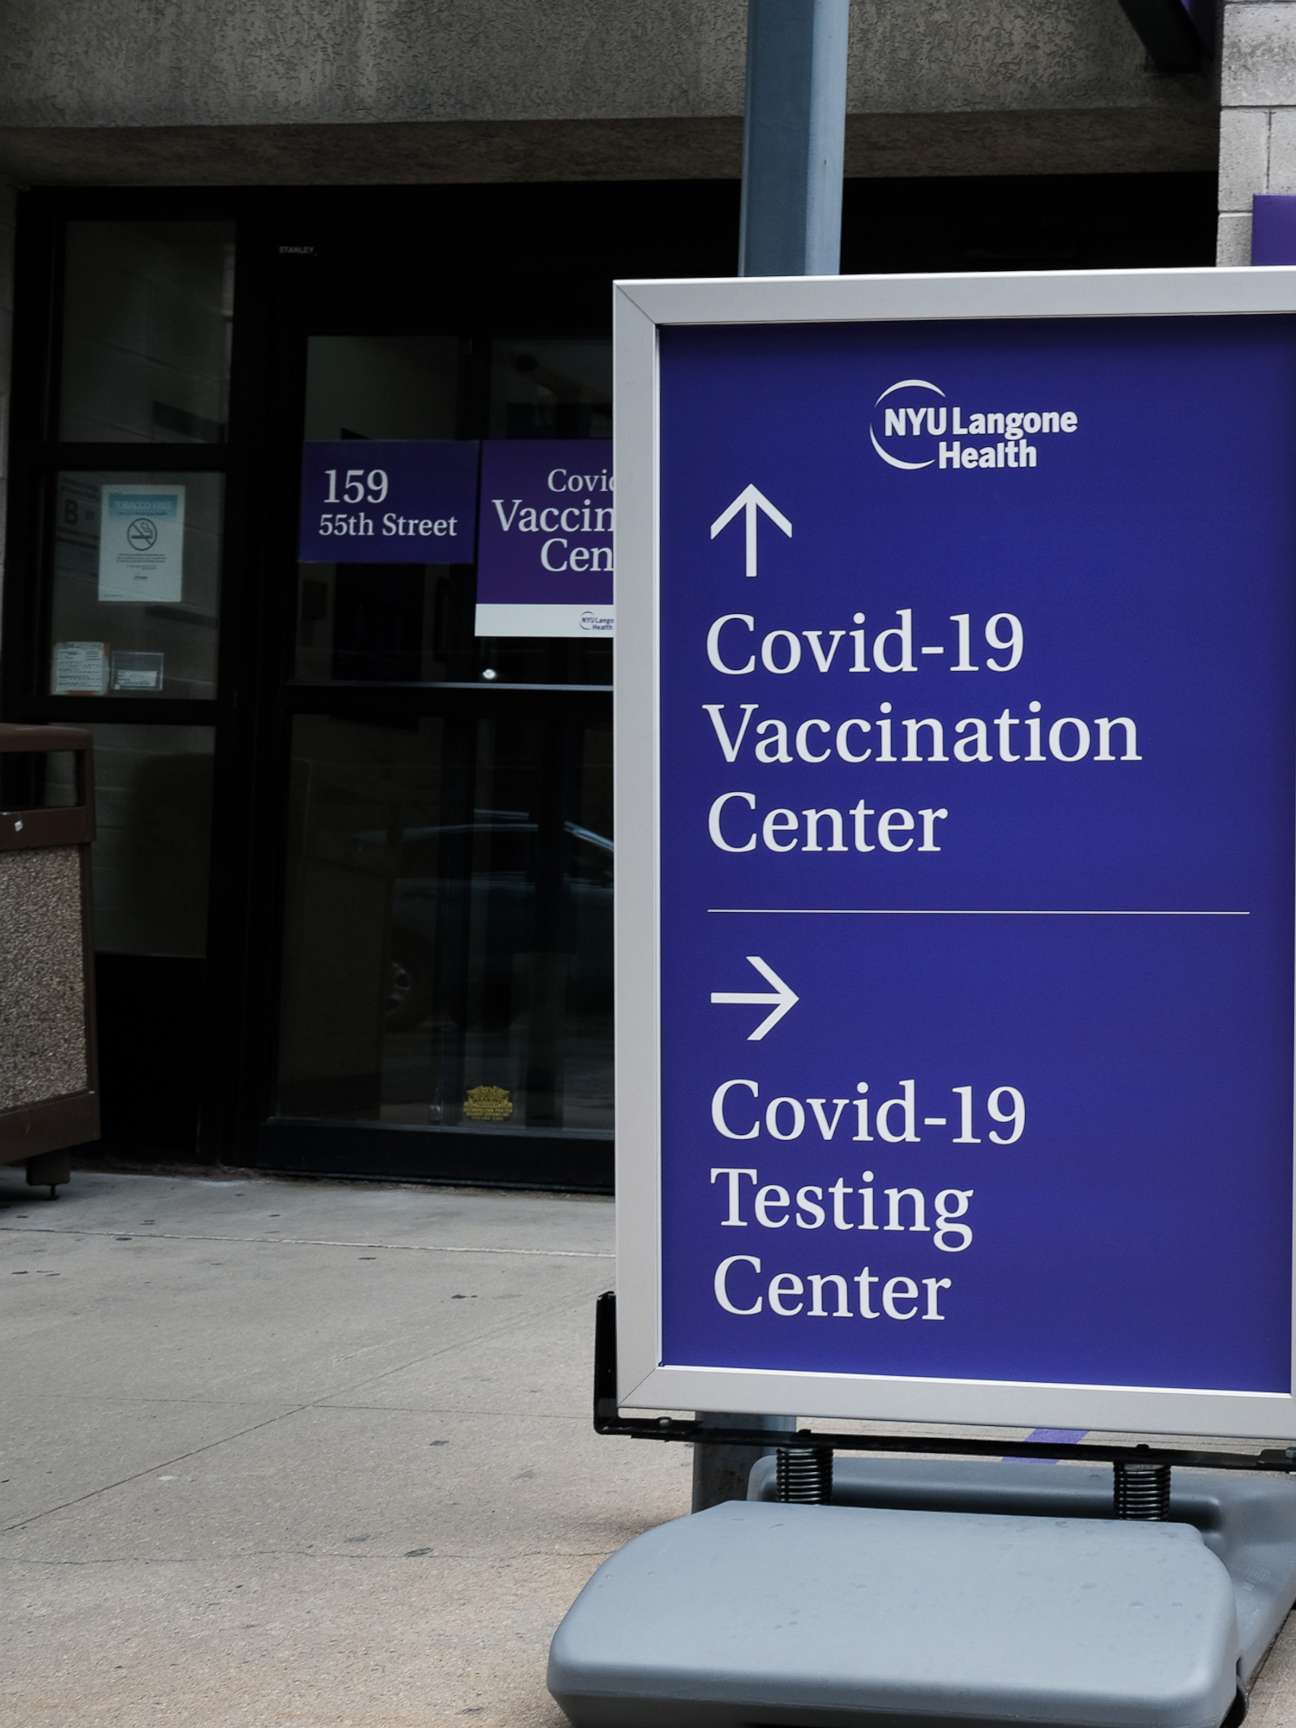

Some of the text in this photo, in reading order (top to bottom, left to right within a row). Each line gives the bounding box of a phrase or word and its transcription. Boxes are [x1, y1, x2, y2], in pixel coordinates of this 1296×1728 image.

[885, 406, 1078, 441] NYU Langone
[938, 440, 1037, 470] Health
[323, 469, 389, 504] 159
[318, 511, 458, 537] 55th Street
[540, 537, 613, 572] Cen
[706, 608, 1025, 675] Covid-19
[701, 700, 1143, 764] Vaccination
[708, 791, 949, 853] Center
[711, 1078, 1026, 1145] Covid-19
[710, 1167, 974, 1253] Testing
[713, 1254, 952, 1321] Center
